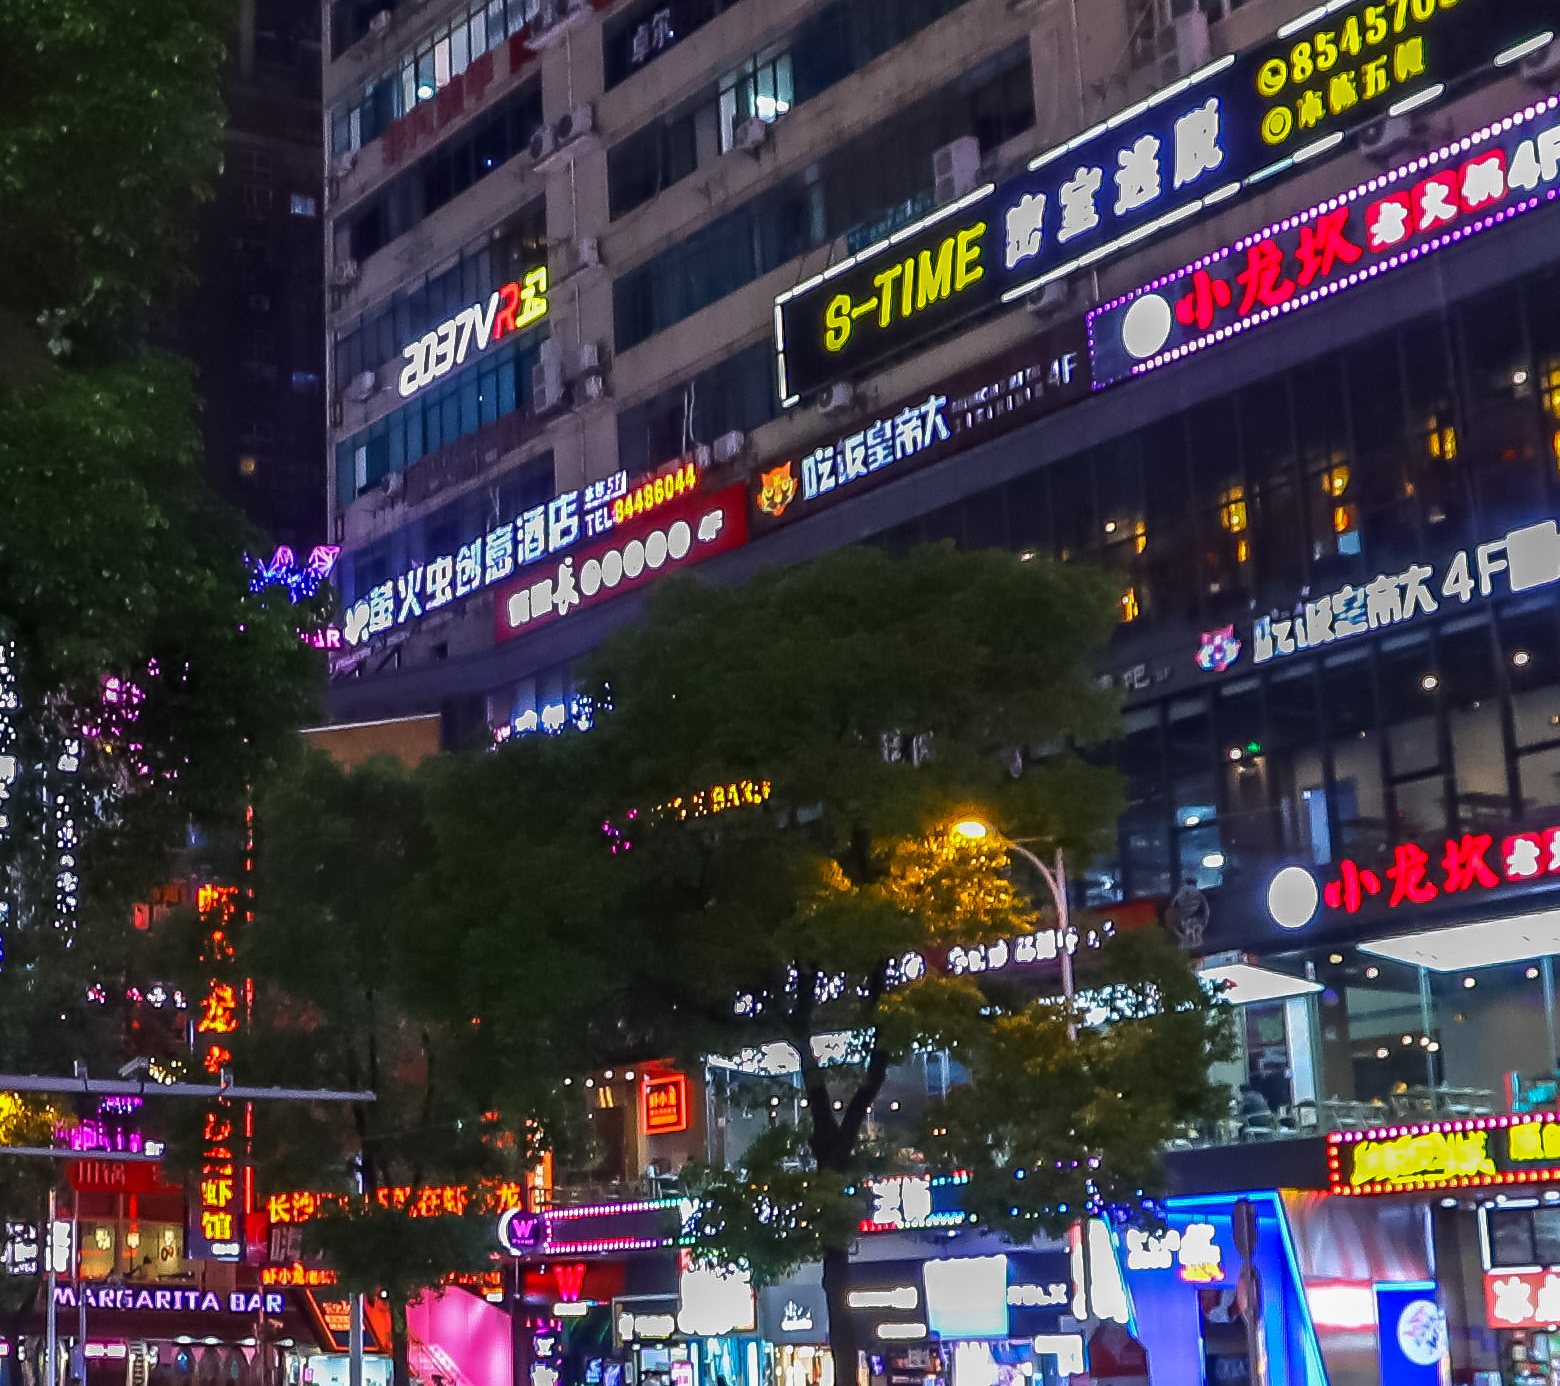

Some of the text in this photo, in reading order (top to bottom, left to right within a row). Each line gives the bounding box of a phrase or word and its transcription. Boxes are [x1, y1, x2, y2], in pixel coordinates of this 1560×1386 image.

[822, 219, 987, 353] S-TIME
[52, 1286, 285, 1314] MARGARITA BAR
